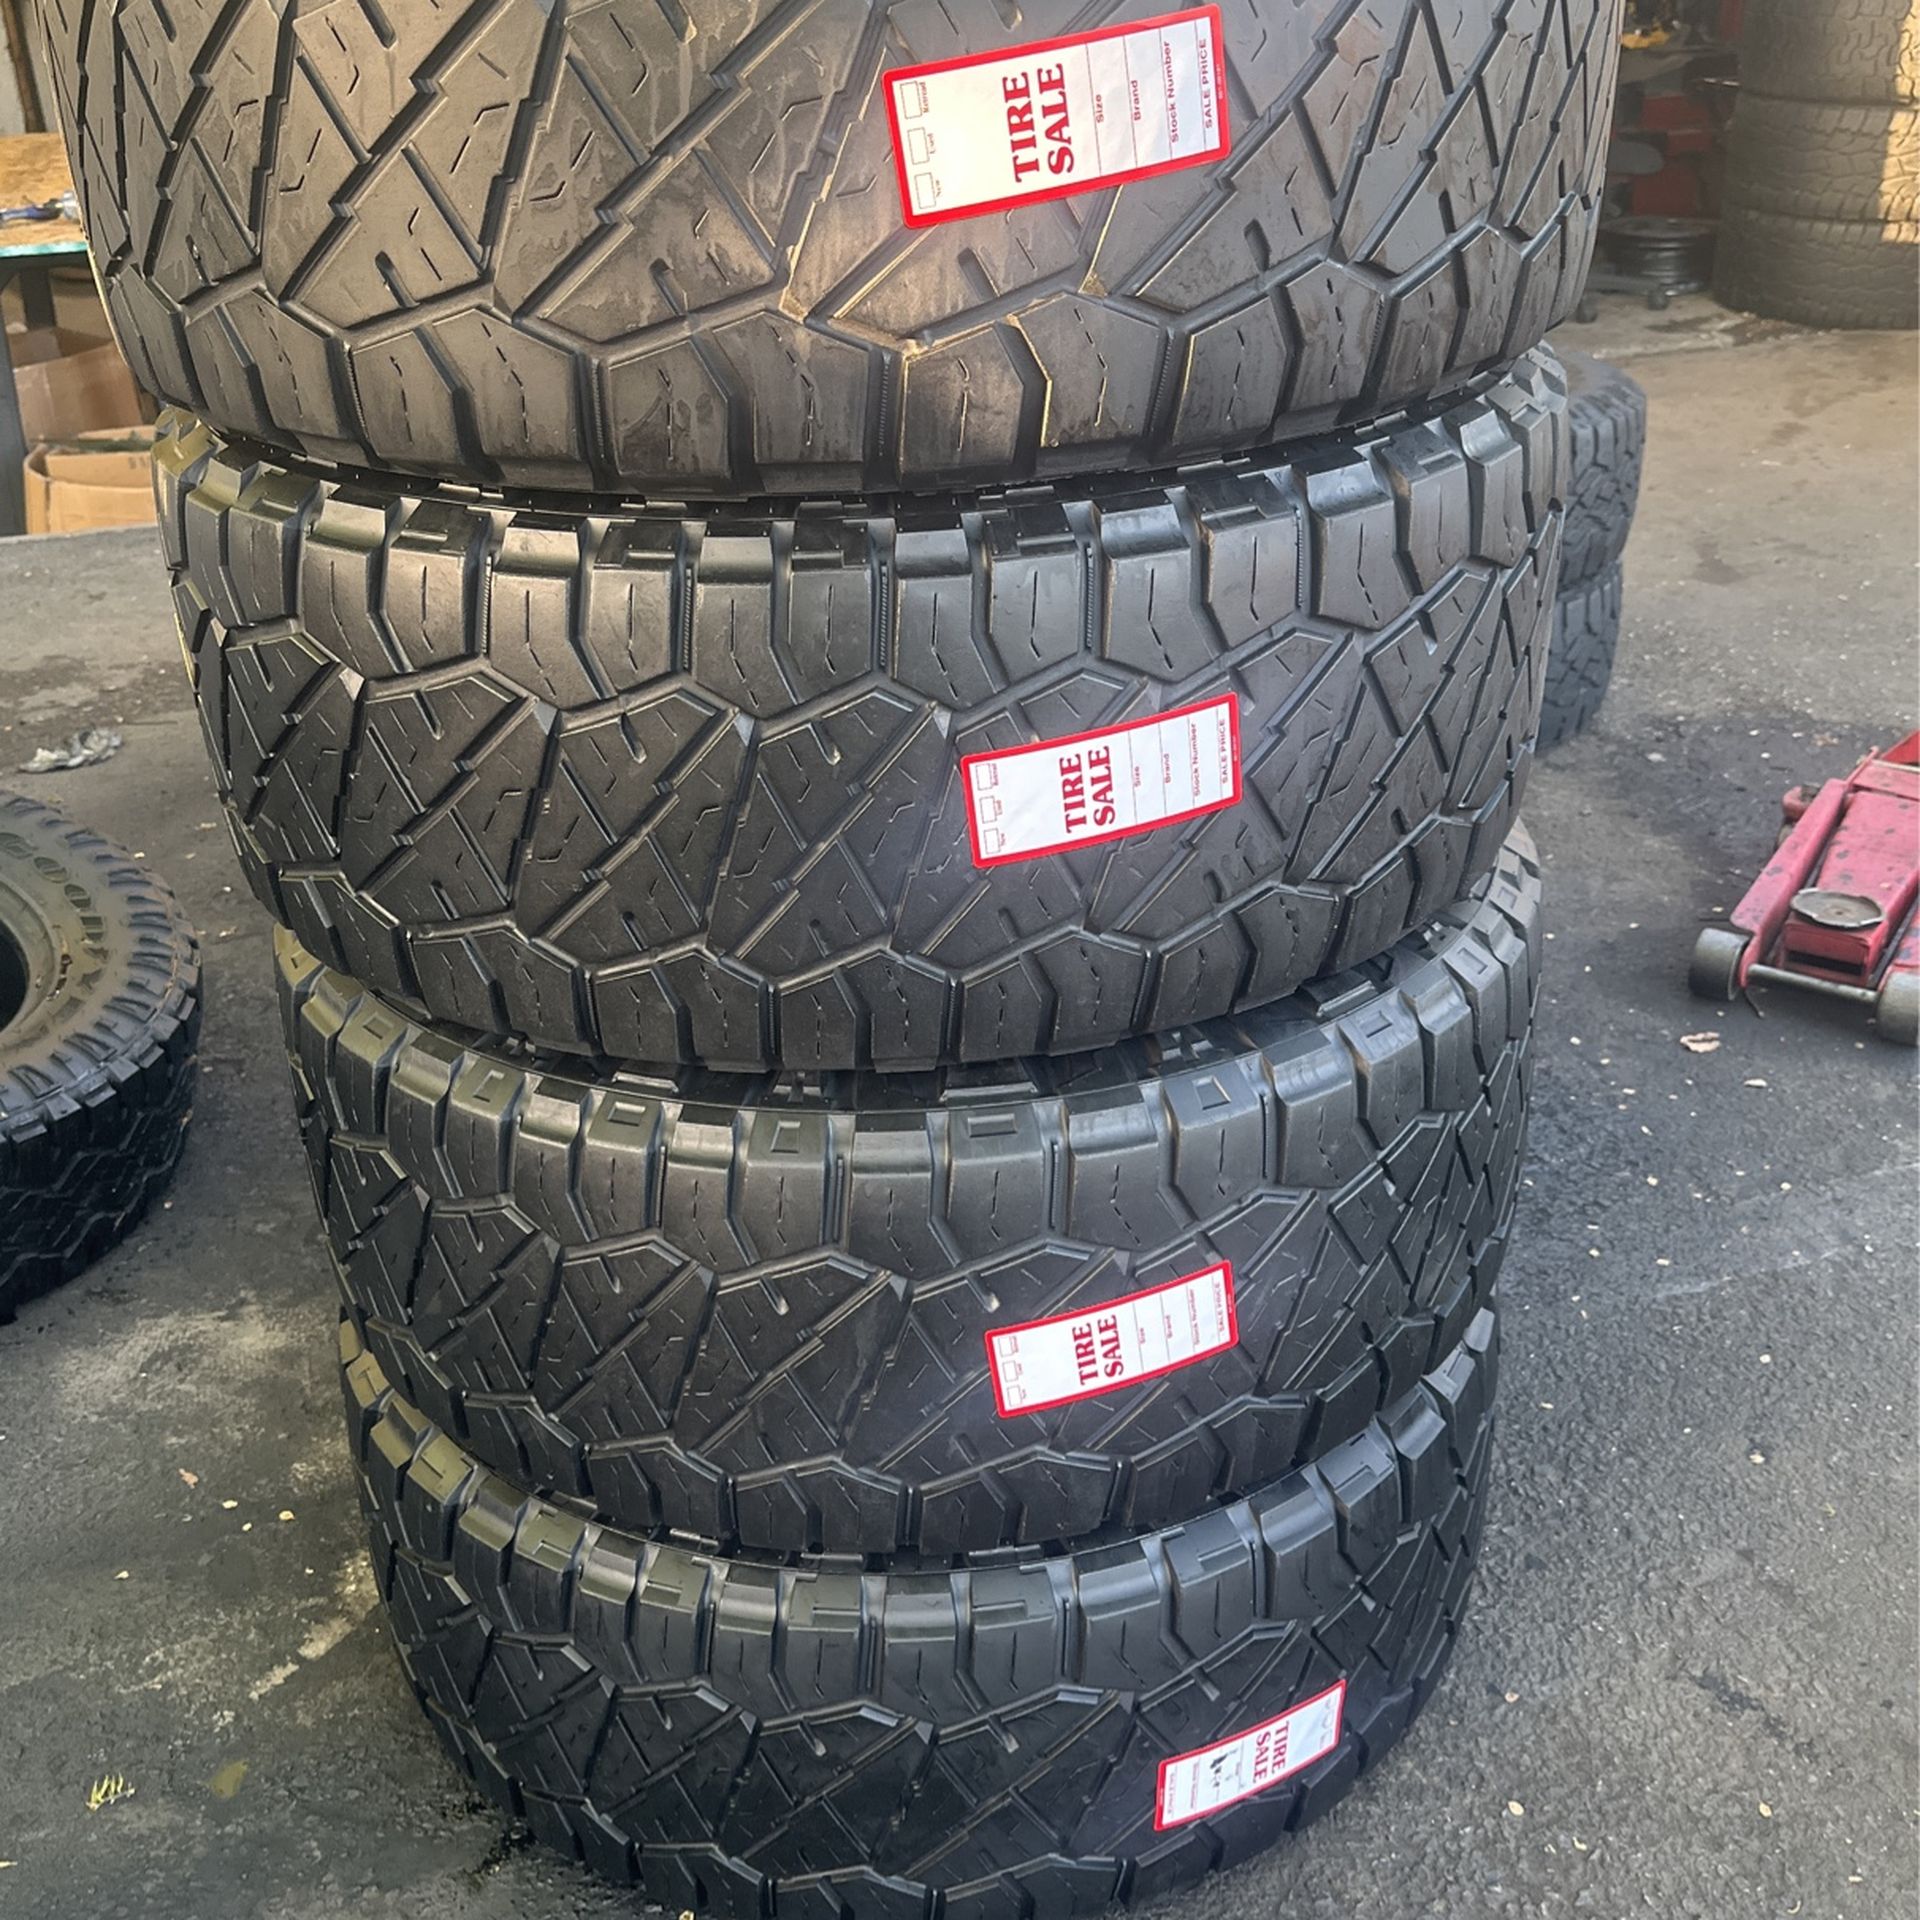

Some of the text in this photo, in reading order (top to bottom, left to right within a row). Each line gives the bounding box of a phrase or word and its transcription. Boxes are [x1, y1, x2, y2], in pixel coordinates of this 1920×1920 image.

[1095, 94, 1104, 124] Size
[1131, 80, 1141, 121] Brand
[1163, 40, 1180, 144] Stock Number
[1198, 38, 1214, 129] SALE PRICE
[1002, 71, 1040, 183] TIRE
[1037, 63, 1074, 175] SALE
[1133, 766, 1141, 788] Size
[1163, 753, 1172, 784] Brand
[1190, 722, 1201, 796] Stock Number
[1217, 719, 1229, 784] SALE PRICE
[1059, 753, 1087, 834] TIRE
[1088, 745, 1116, 827] SALE
[1072, 1321, 1099, 1386] TIRE
[1098, 1314, 1124, 1379] SALE
[1253, 1730, 1272, 1784] SALE
[1271, 1719, 1290, 1775] TIRE
